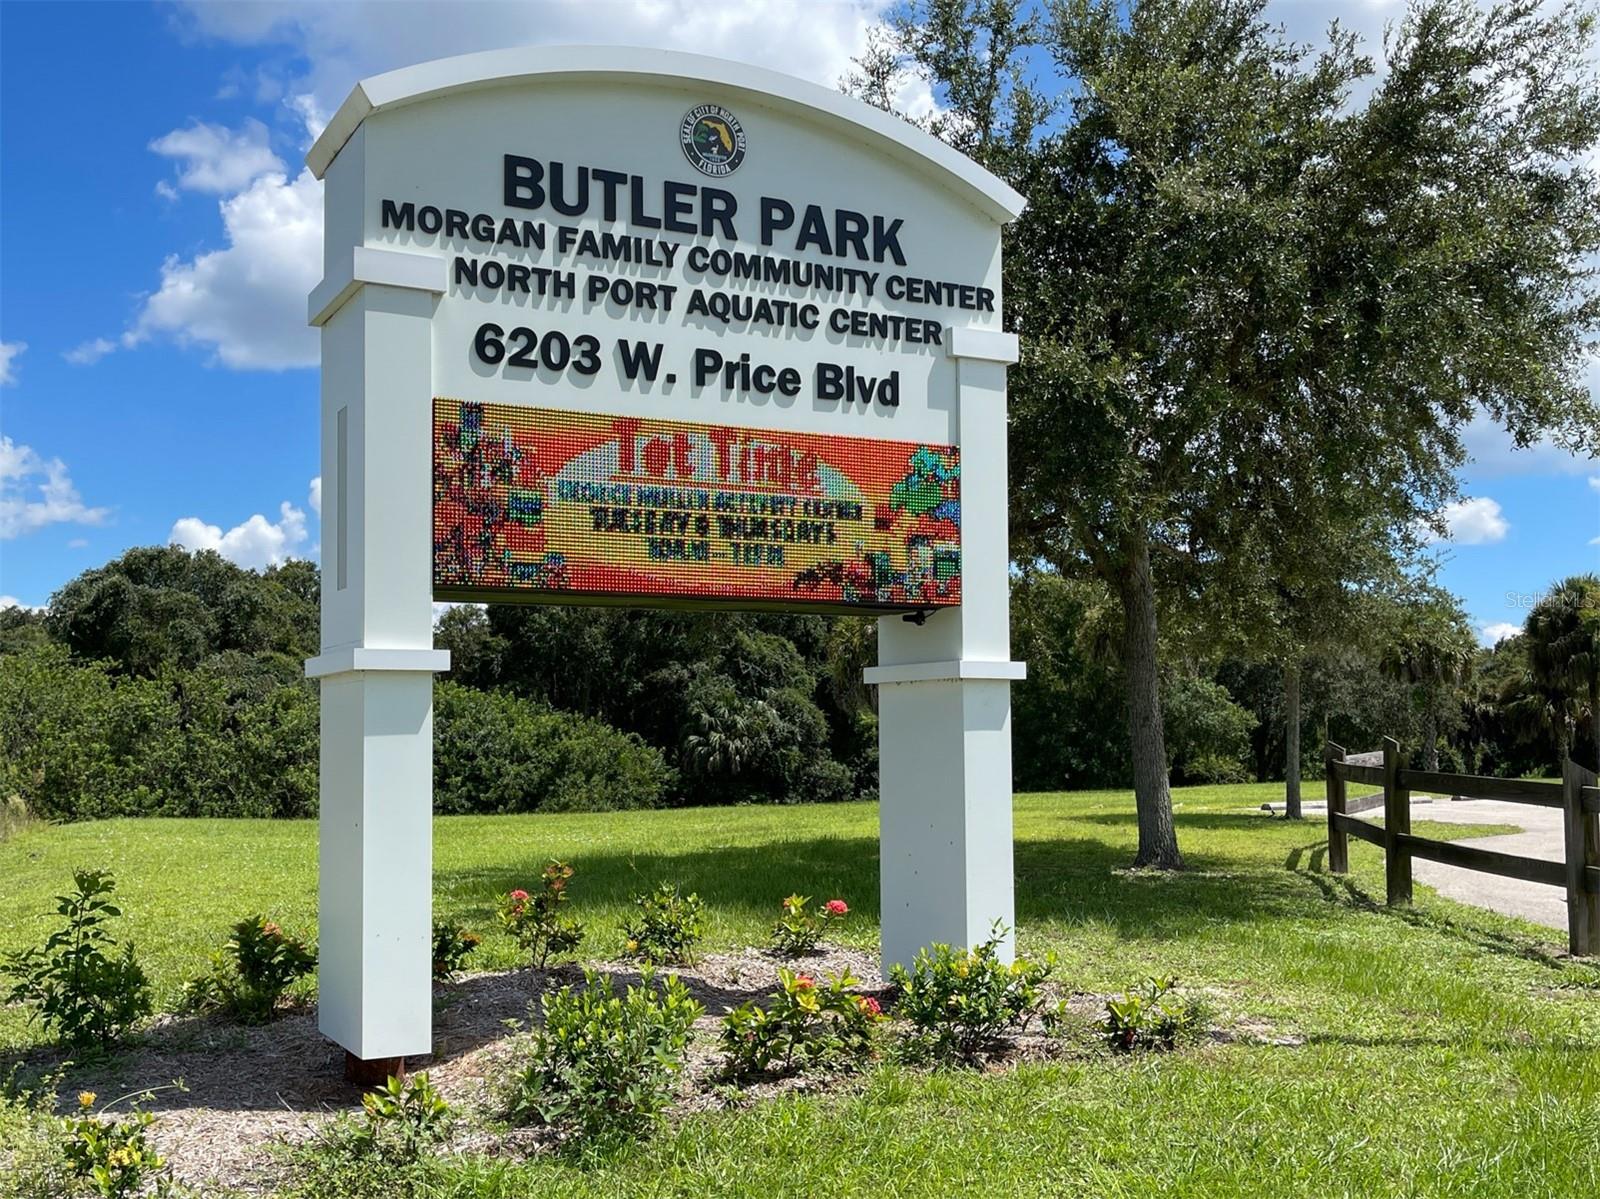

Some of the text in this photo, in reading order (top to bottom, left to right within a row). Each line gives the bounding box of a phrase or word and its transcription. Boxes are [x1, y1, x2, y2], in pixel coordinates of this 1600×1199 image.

[683, 124, 692, 144] SEAL
[720, 108, 741, 131] NORTH
[699, 159, 731, 174] FLORIDA
[503, 154, 908, 267] BUTLER PARK
[381, 200, 996, 313] MORGAN FAMILY COMMUNITY CENTER
[454, 256, 943, 346] NORTH PORT AQUATIC CENTER
[474, 322, 901, 408] 6203 W. Price Blvd
